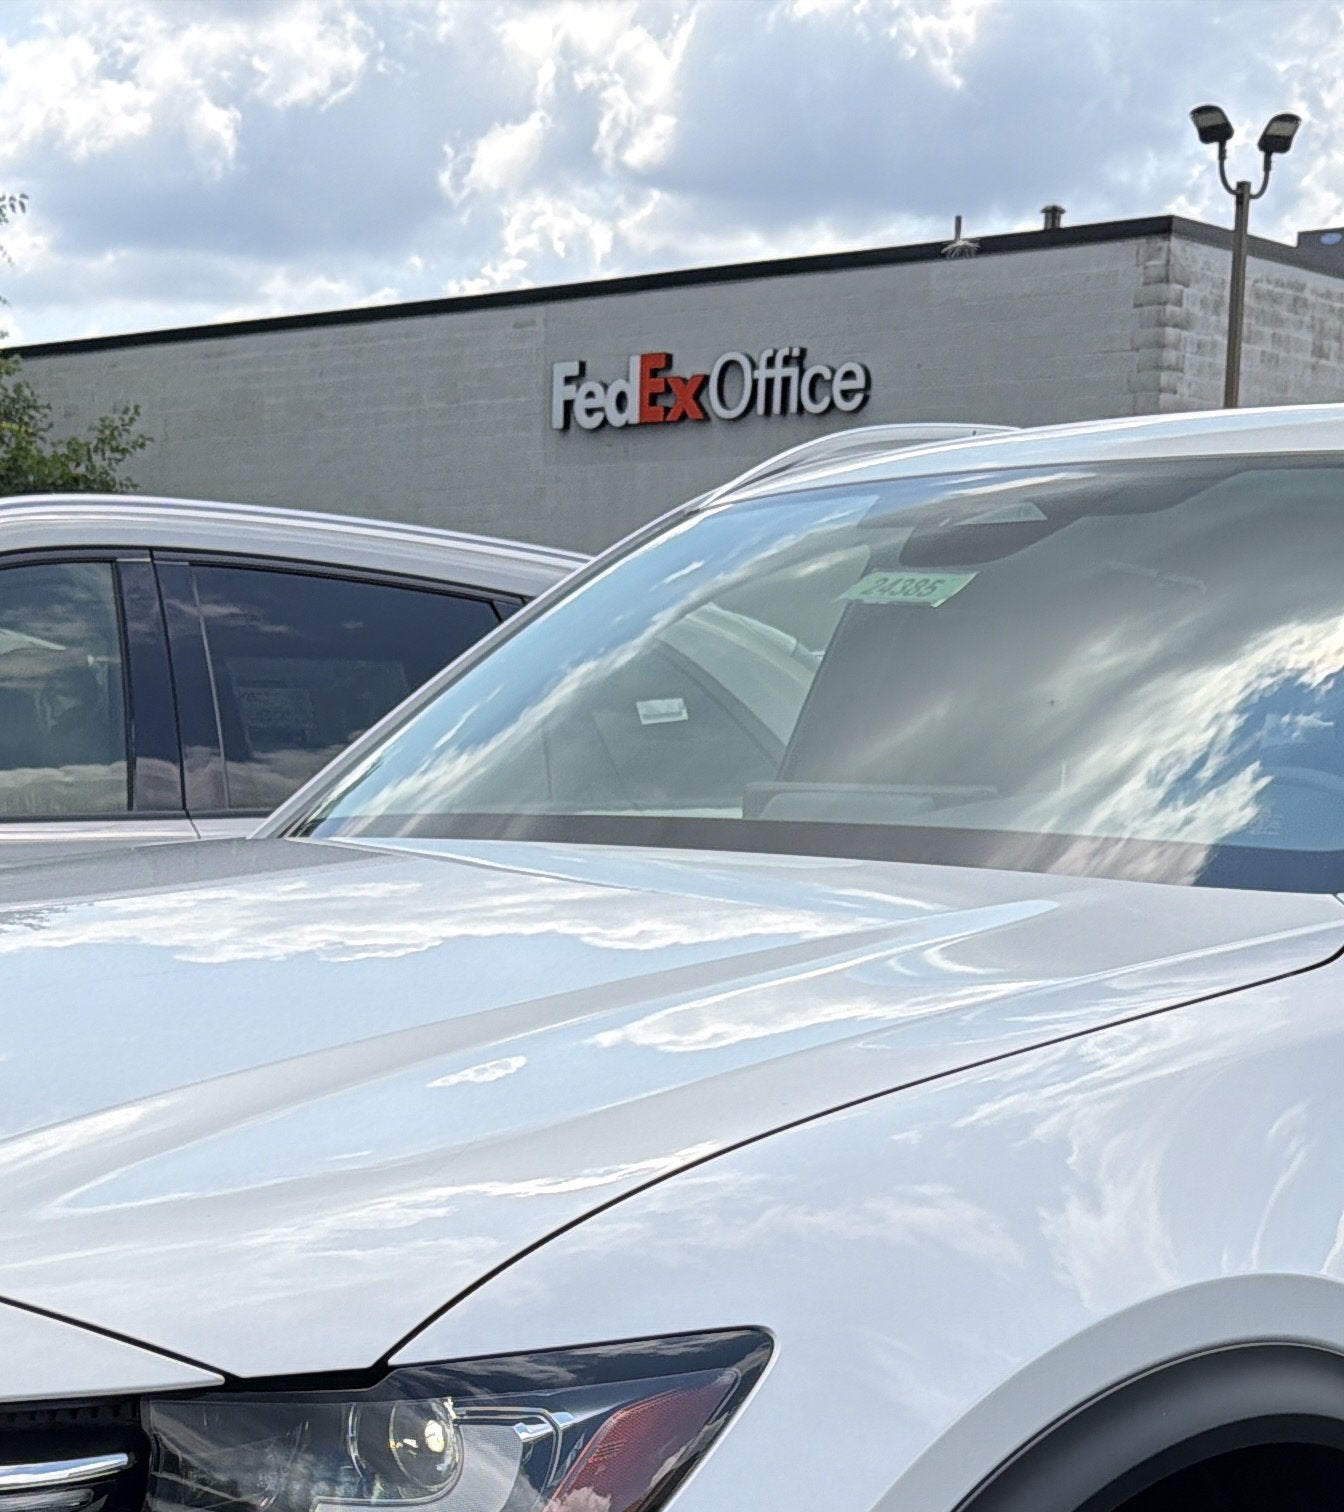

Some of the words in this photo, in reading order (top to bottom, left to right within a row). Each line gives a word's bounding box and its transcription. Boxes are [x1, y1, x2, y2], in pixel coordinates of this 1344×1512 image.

[552, 352, 706, 430] FedEx
[708, 346, 871, 420] Office
[860, 576, 946, 598] 24385
